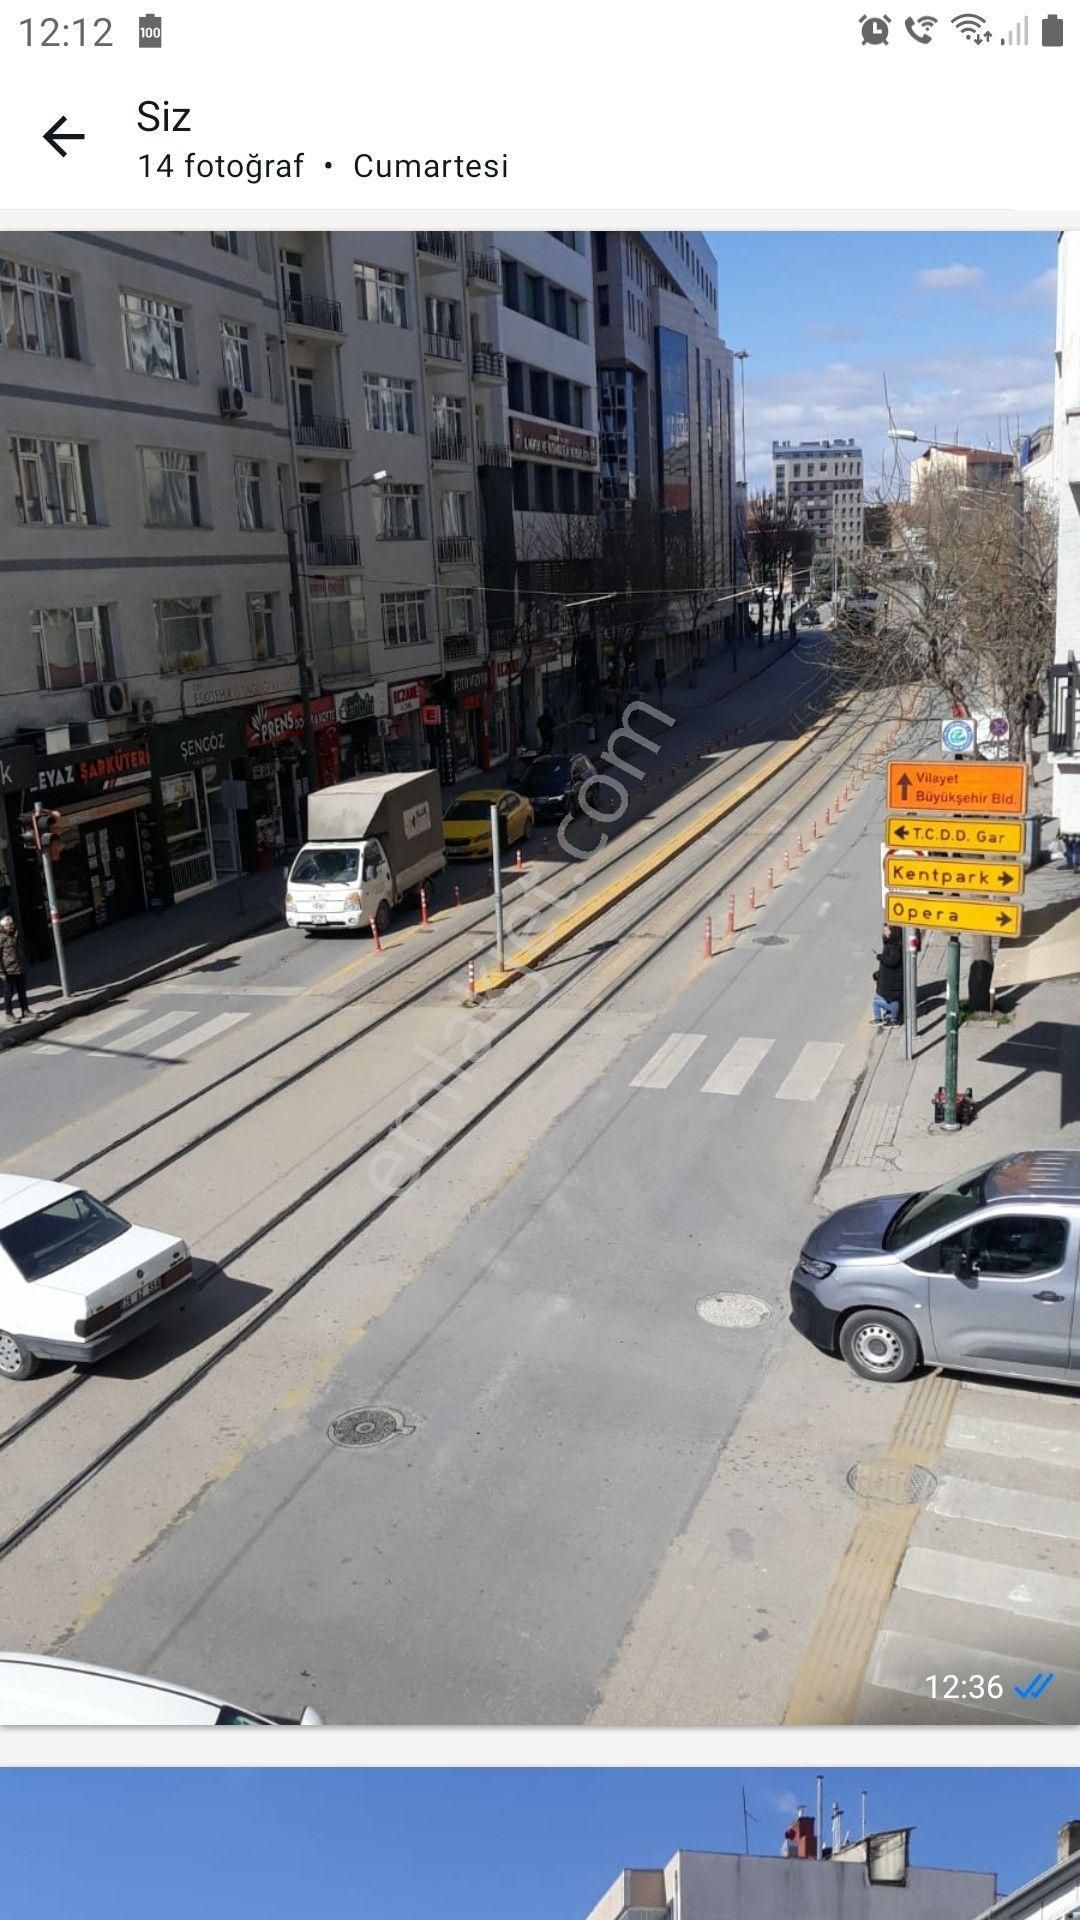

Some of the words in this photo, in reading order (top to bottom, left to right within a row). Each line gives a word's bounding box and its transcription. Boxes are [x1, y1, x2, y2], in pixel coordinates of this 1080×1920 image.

[19, 17, 113, 47] 12:12
[140, 27, 161, 38] 100
[137, 100, 191, 132] Siz
[139, 153, 174, 178] 14
[184, 152, 305, 185] fotoğraf
[354, 153, 507, 178] Cumartesi
[262, 710, 294, 743] PRENS
[180, 731, 225, 762] ŞENGÖZ
[30, 765, 75, 792] EYAZ
[80, 742, 151, 786] ŞARKÜTERİ
[916, 771, 959, 786] Vilayet
[915, 790, 988, 806] Büyükşehir
[913, 827, 970, 842] T.C.D.D.
[976, 830, 1006, 844] Gar
[892, 865, 989, 886] Kentpark
[892, 902, 959, 921] Opera
